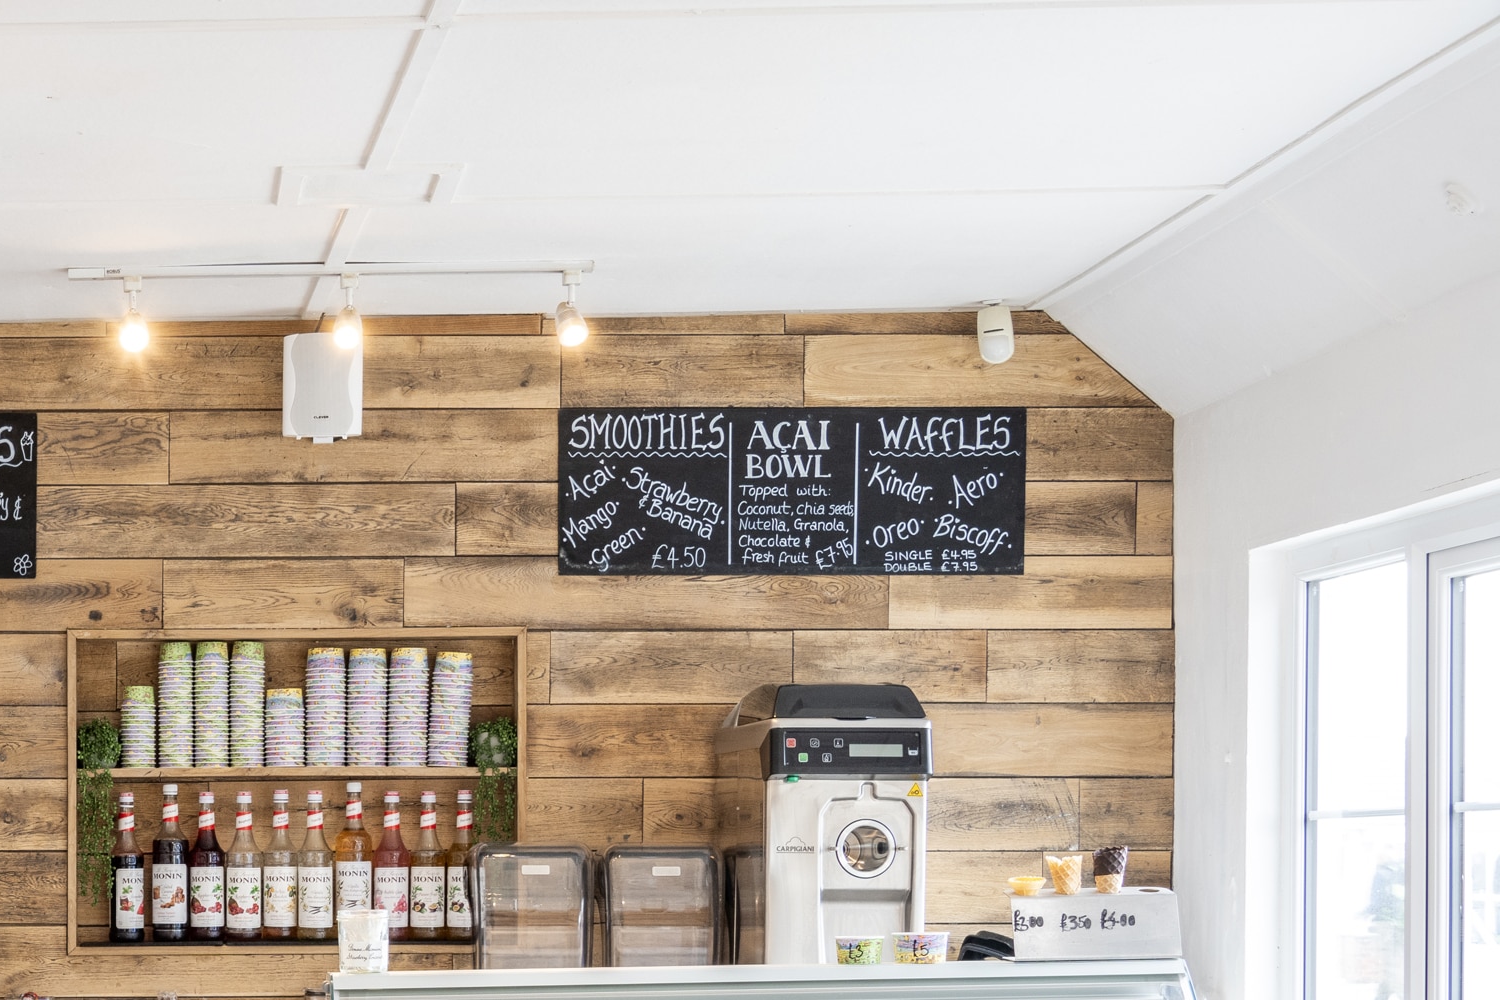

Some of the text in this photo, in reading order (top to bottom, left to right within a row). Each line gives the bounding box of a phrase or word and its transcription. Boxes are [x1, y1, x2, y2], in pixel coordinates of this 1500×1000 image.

[568, 413, 725, 451] SMOOTHIES
[748, 421, 830, 455] AÇAI
[878, 415, 1010, 453] WAFFLES
[745, 454, 831, 478] BOWL
[626, 467, 722, 525] Strawberry
[738, 484, 789, 499] Topped
[868, 462, 932, 504] Kinder
[953, 466, 998, 509] Aero
[646, 499, 713, 541] Banana
[796, 502, 826, 516] chia
[562, 501, 617, 548] Mango
[873, 518, 920, 548] Oreo
[933, 514, 1009, 555] Biscoff
[738, 534, 800, 548] Chocolate
[816, 538, 854, 569] £7.95
[884, 550, 977, 561] SINGLE £4.95
[651, 544, 706, 569] £4.50
[884, 561, 978, 572] DOUBLE £7.95
[153, 872, 182, 880] MONIN
[229, 876, 259, 884] MONIN
